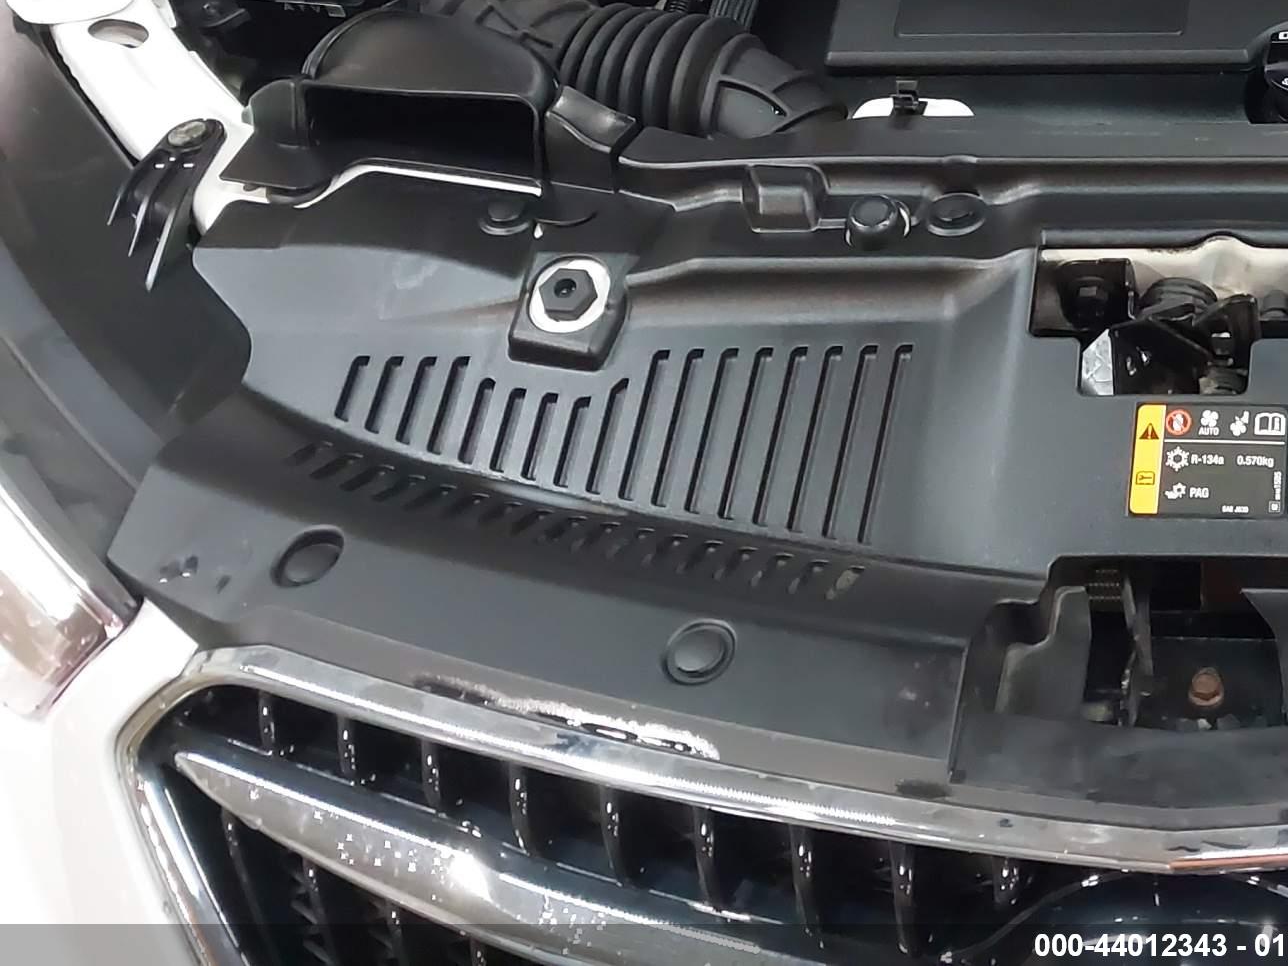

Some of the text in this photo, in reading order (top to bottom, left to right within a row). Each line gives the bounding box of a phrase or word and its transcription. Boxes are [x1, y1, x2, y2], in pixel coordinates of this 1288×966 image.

[1198, 426, 1219, 436] AUTO
[1190, 453, 1275, 468] R-134a 0.570kg
[1189, 486, 1210, 499] PAG
